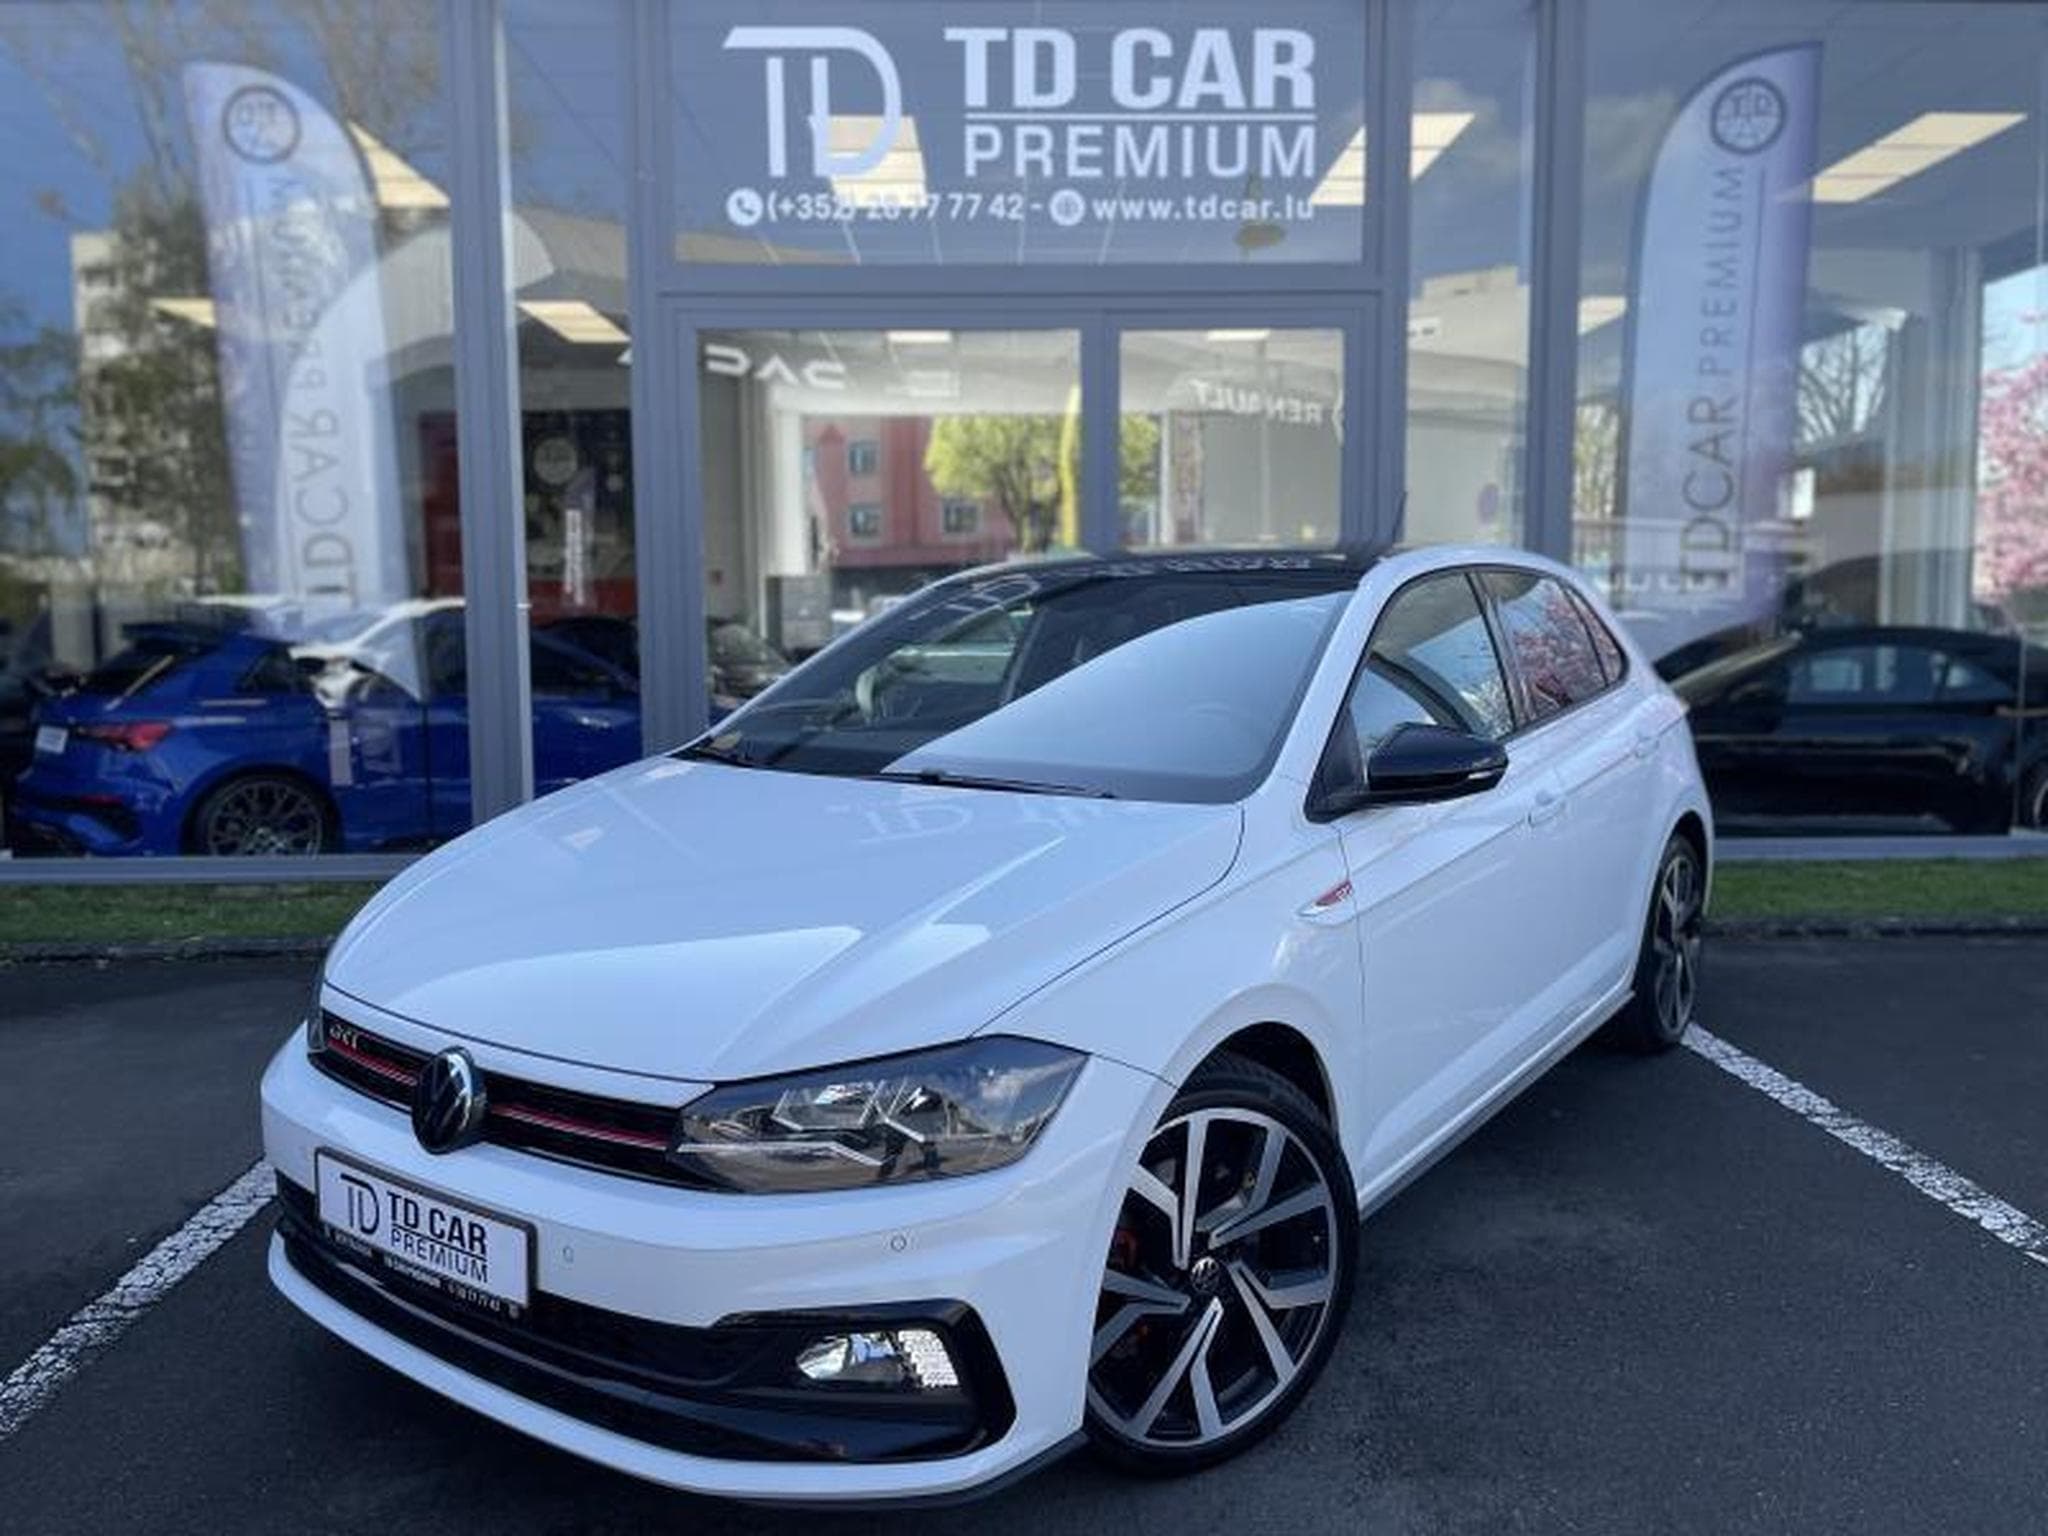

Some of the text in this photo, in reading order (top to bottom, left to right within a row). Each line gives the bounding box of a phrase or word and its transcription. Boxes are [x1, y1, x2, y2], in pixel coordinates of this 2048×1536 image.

[944, 28, 1316, 109] TD CAR
[964, 125, 1316, 178] PREMIUM
[1092, 192, 1315, 220] www.tdcar.lu
[1700, 164, 1746, 376] PREMIUM
[387, 1191, 487, 1255] TD CAR
[391, 1229, 488, 1284] PREMIUM
